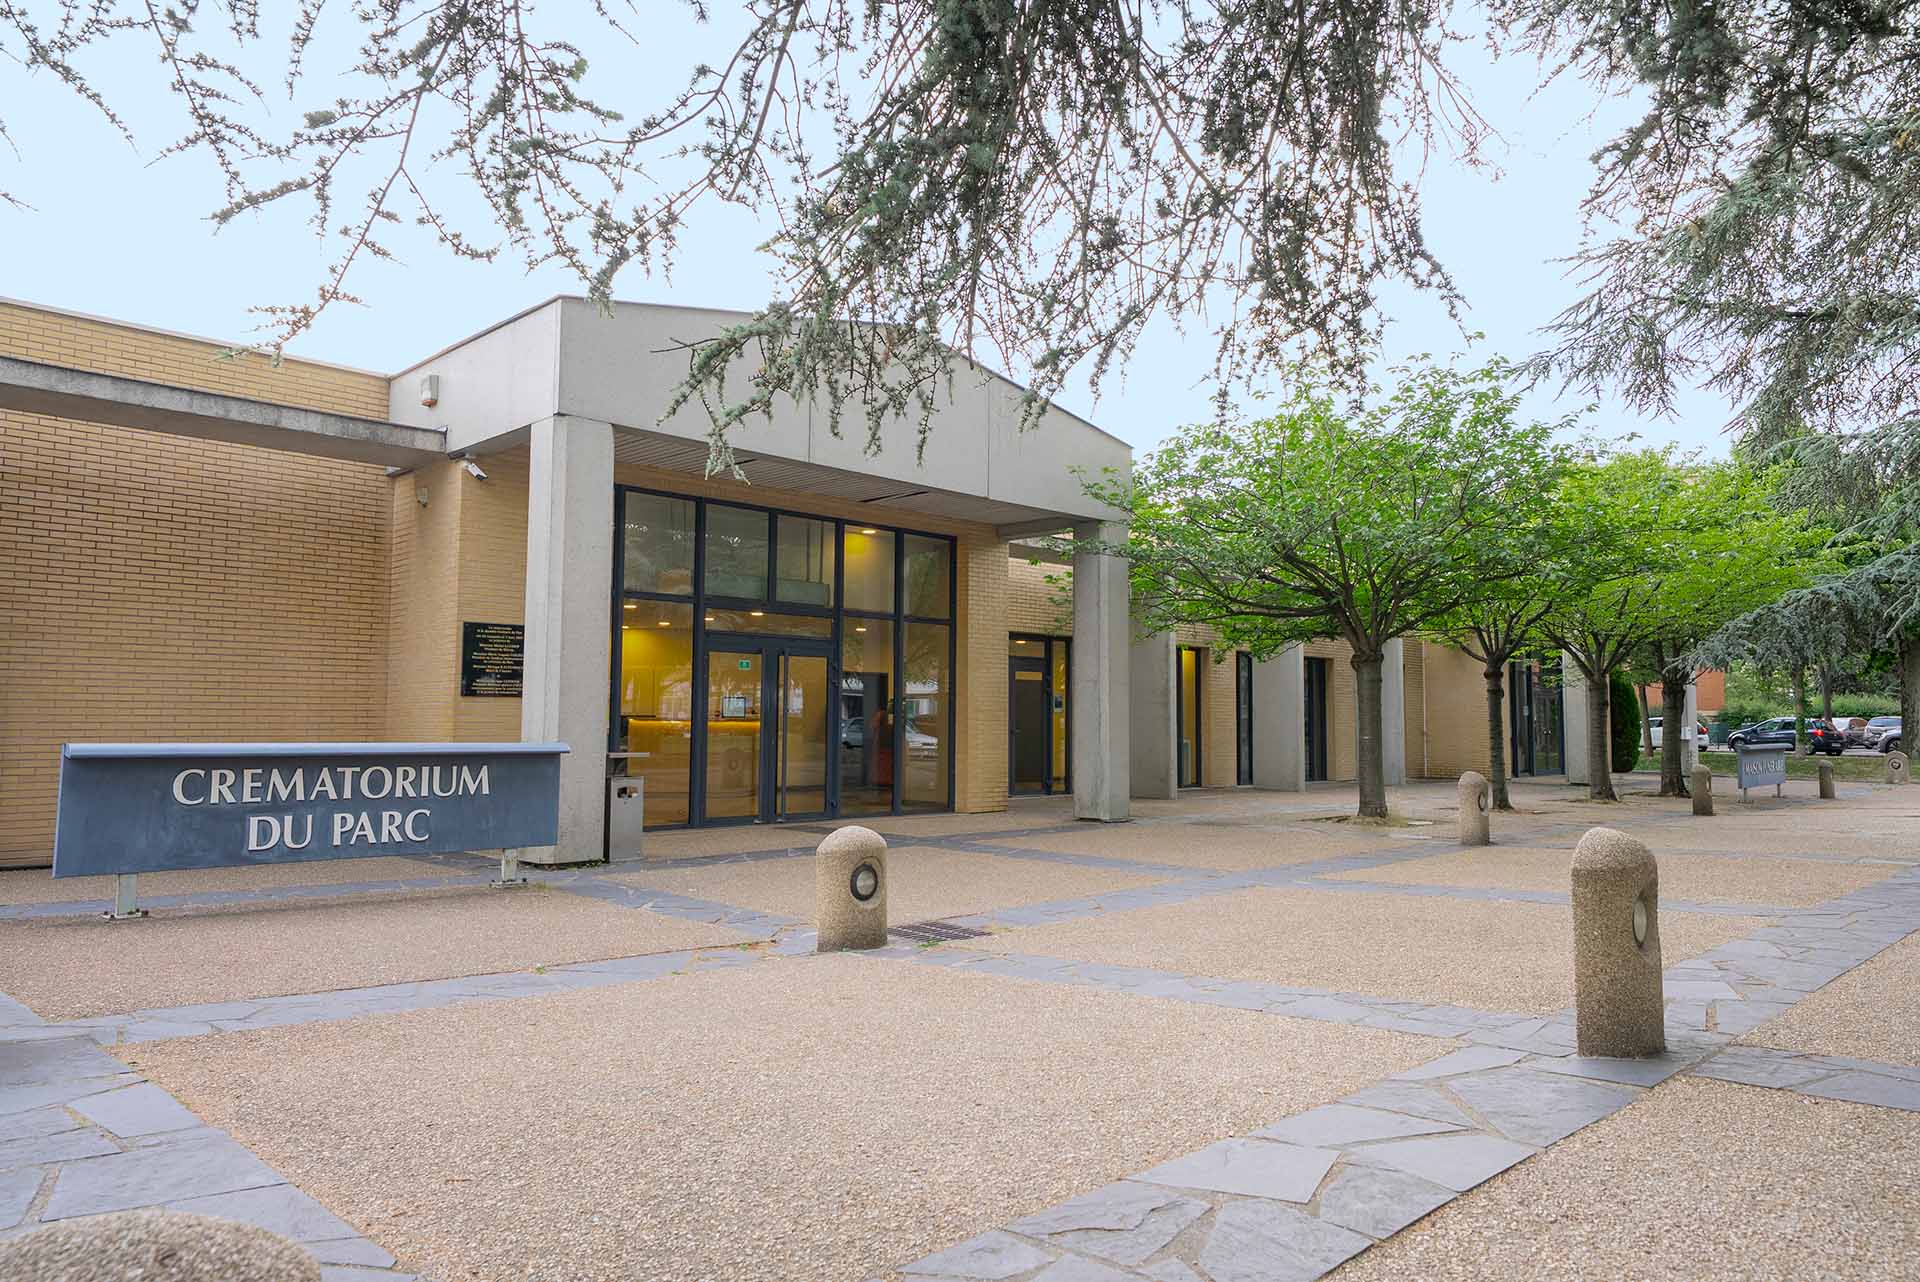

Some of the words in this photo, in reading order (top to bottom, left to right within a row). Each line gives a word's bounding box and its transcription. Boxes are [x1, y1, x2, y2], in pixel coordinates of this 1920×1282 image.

[173, 765, 490, 805] CREMATORIUM
[248, 814, 313, 851] DU
[332, 809, 431, 846] PARC
